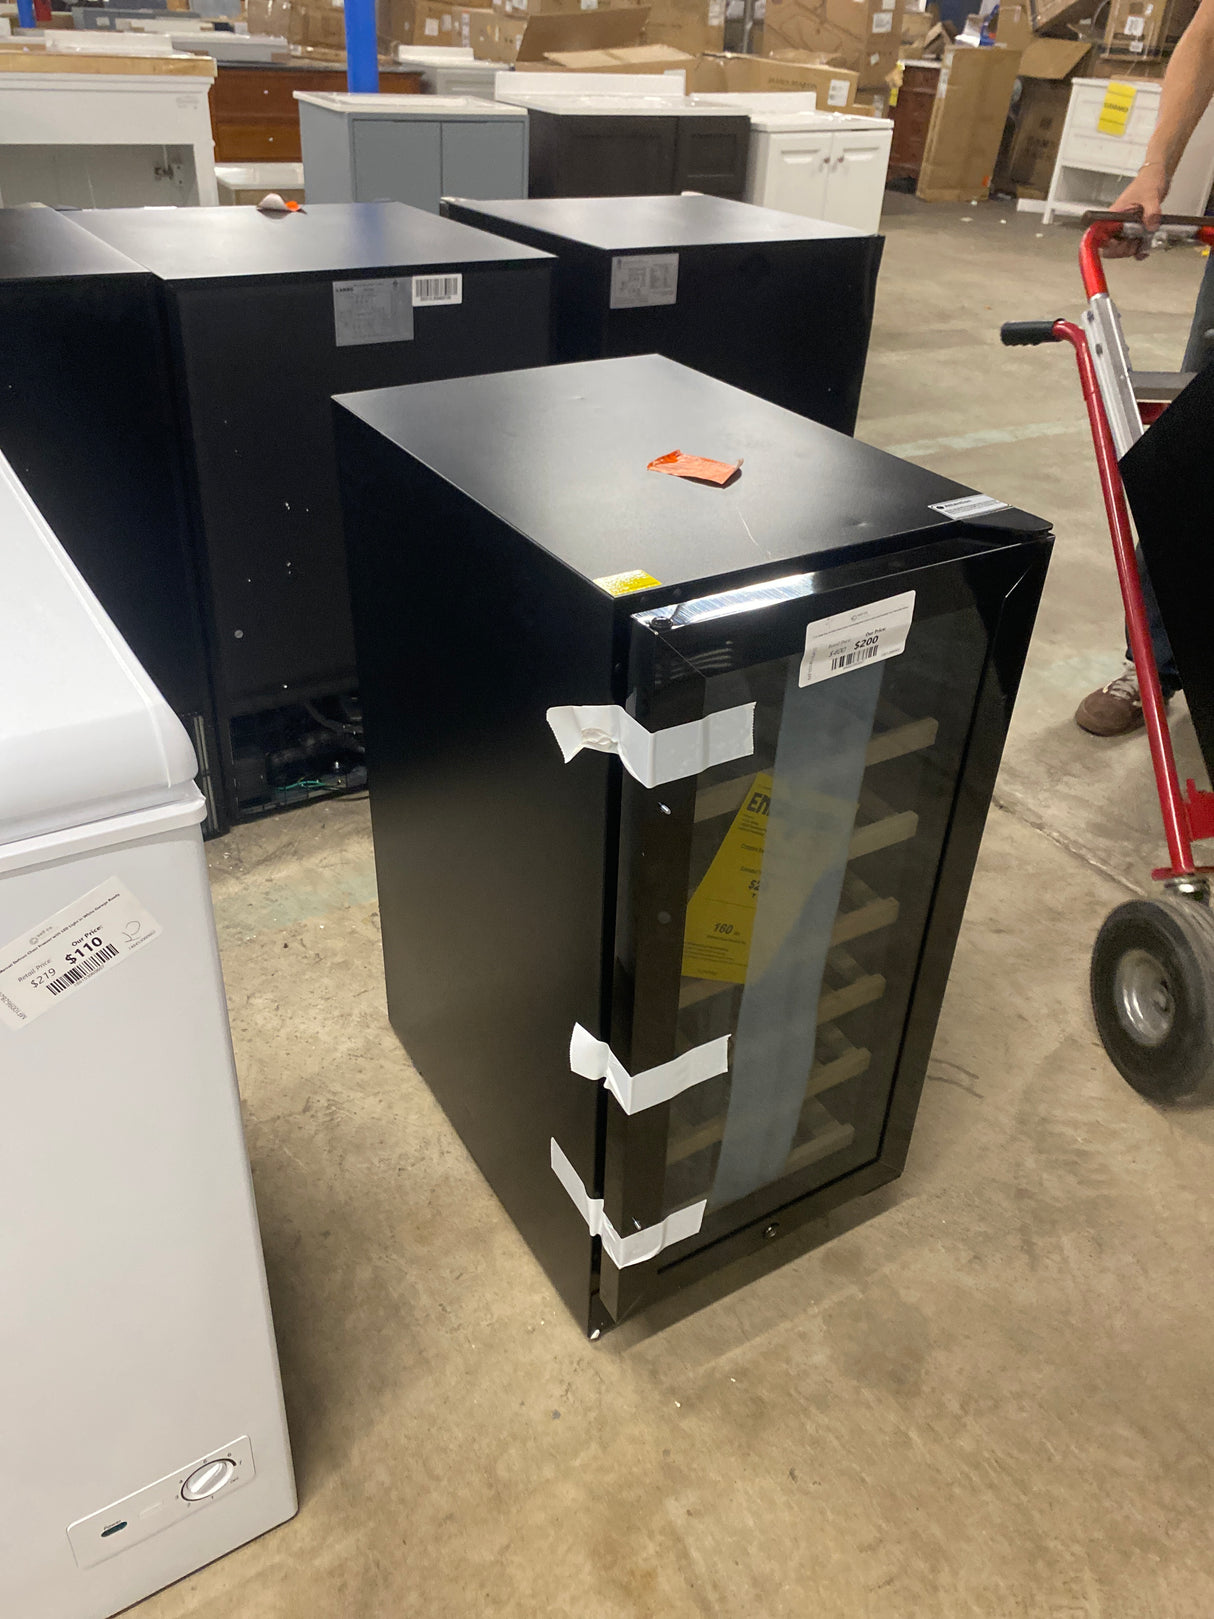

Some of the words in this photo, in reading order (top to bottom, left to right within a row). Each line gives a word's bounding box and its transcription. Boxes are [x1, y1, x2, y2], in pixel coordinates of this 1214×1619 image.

[854, 636, 878, 650] $200
[72, 938, 84, 947] Our
[84, 925, 103, 939] Price:
[713, 922, 733, 935] 160
[65, 937, 103, 965] $110
[18, 967, 36, 982] Retail
[30, 968, 56, 988] $219
